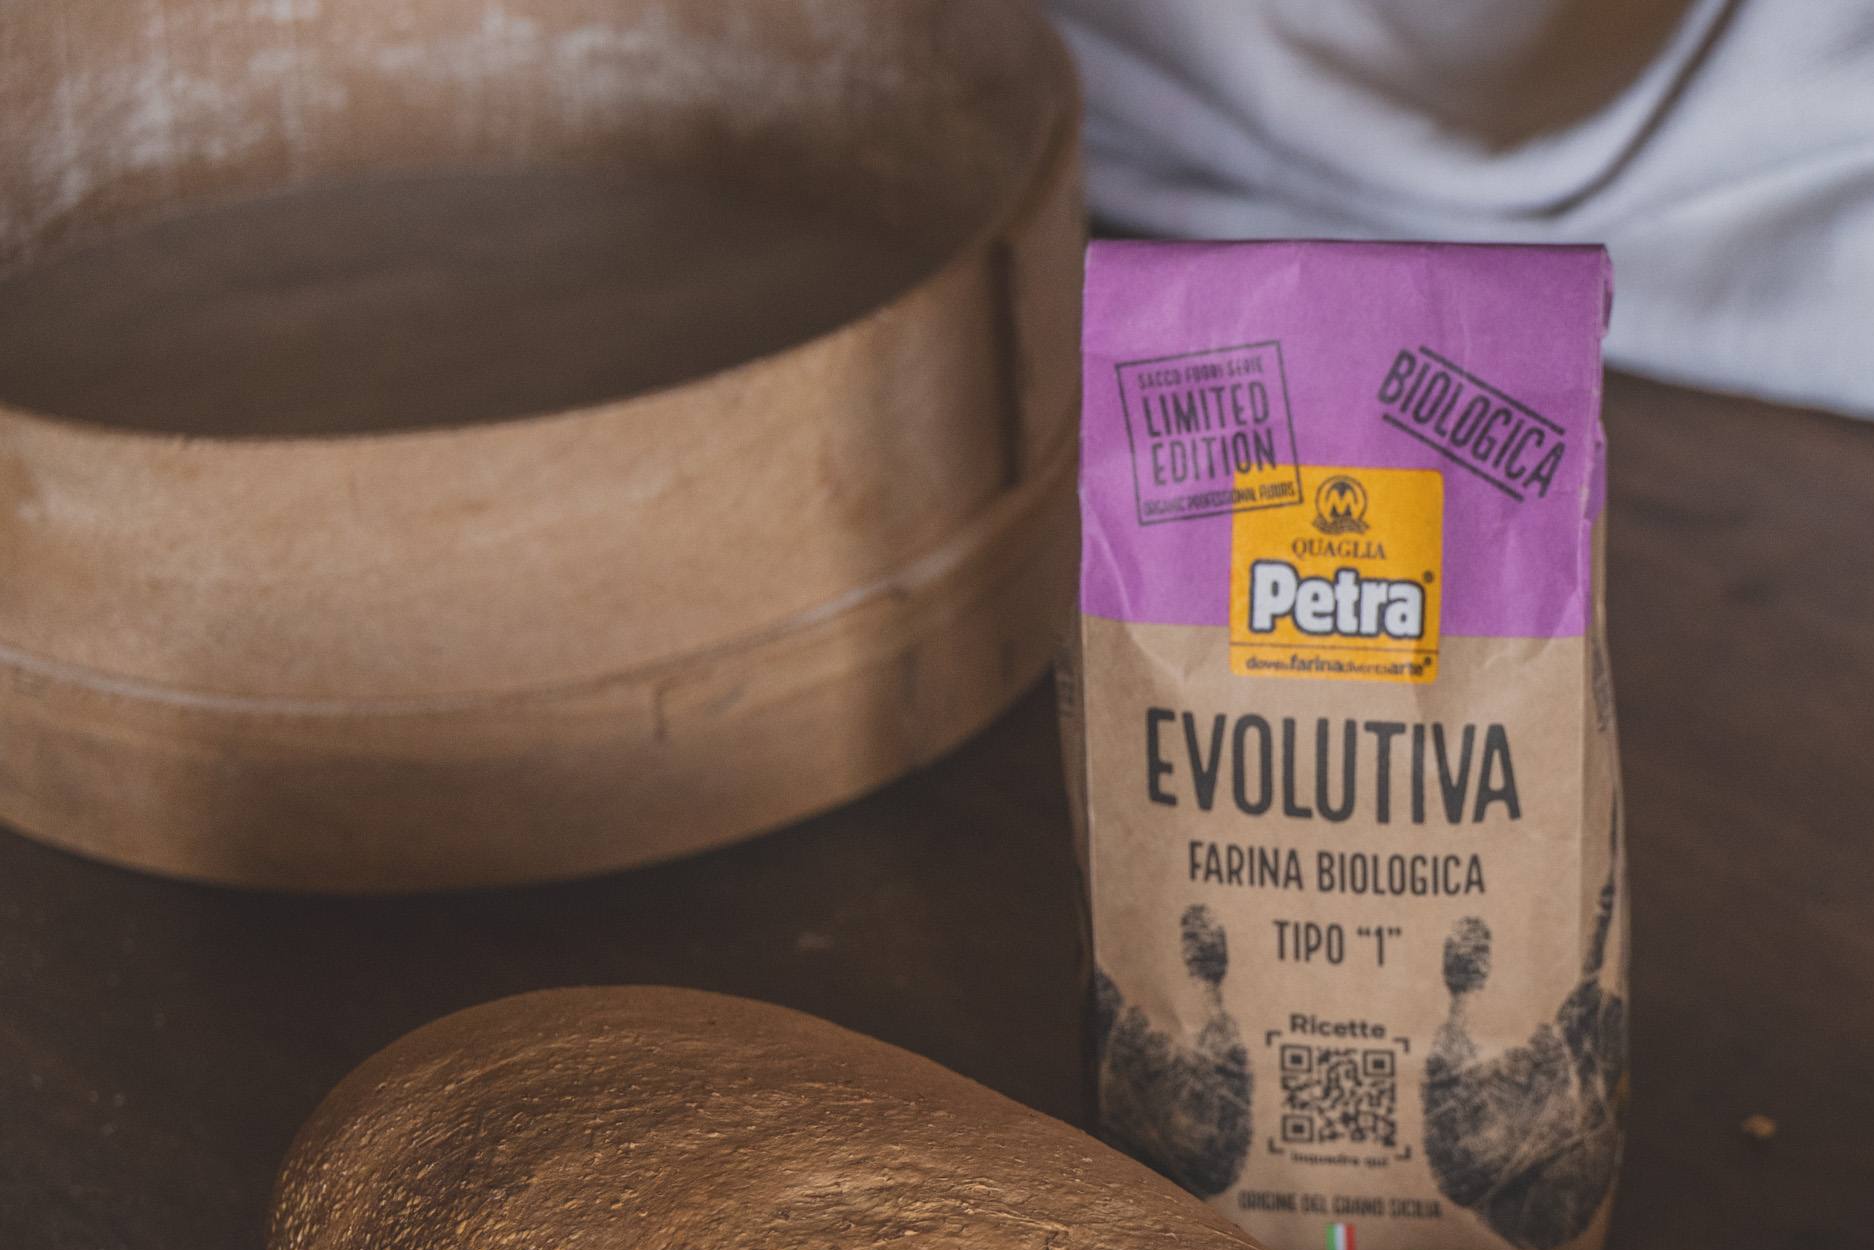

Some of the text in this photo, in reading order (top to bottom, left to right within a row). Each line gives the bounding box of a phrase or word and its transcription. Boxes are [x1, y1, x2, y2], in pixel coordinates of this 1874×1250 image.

[1141, 381, 1270, 437] LIMITED
[1376, 349, 1566, 499] BIOLOGICA
[1151, 428, 1277, 486] EDITION
[1292, 537, 1387, 560] QUAGLIA
[1249, 558, 1426, 639] Petra
[1146, 706, 1522, 825] EVOLUTIVA
[1188, 840, 1486, 896] FARINA BIOLOGICA
[1272, 920, 1344, 965] TIPO
[1290, 1012, 1386, 1039] Ricette
